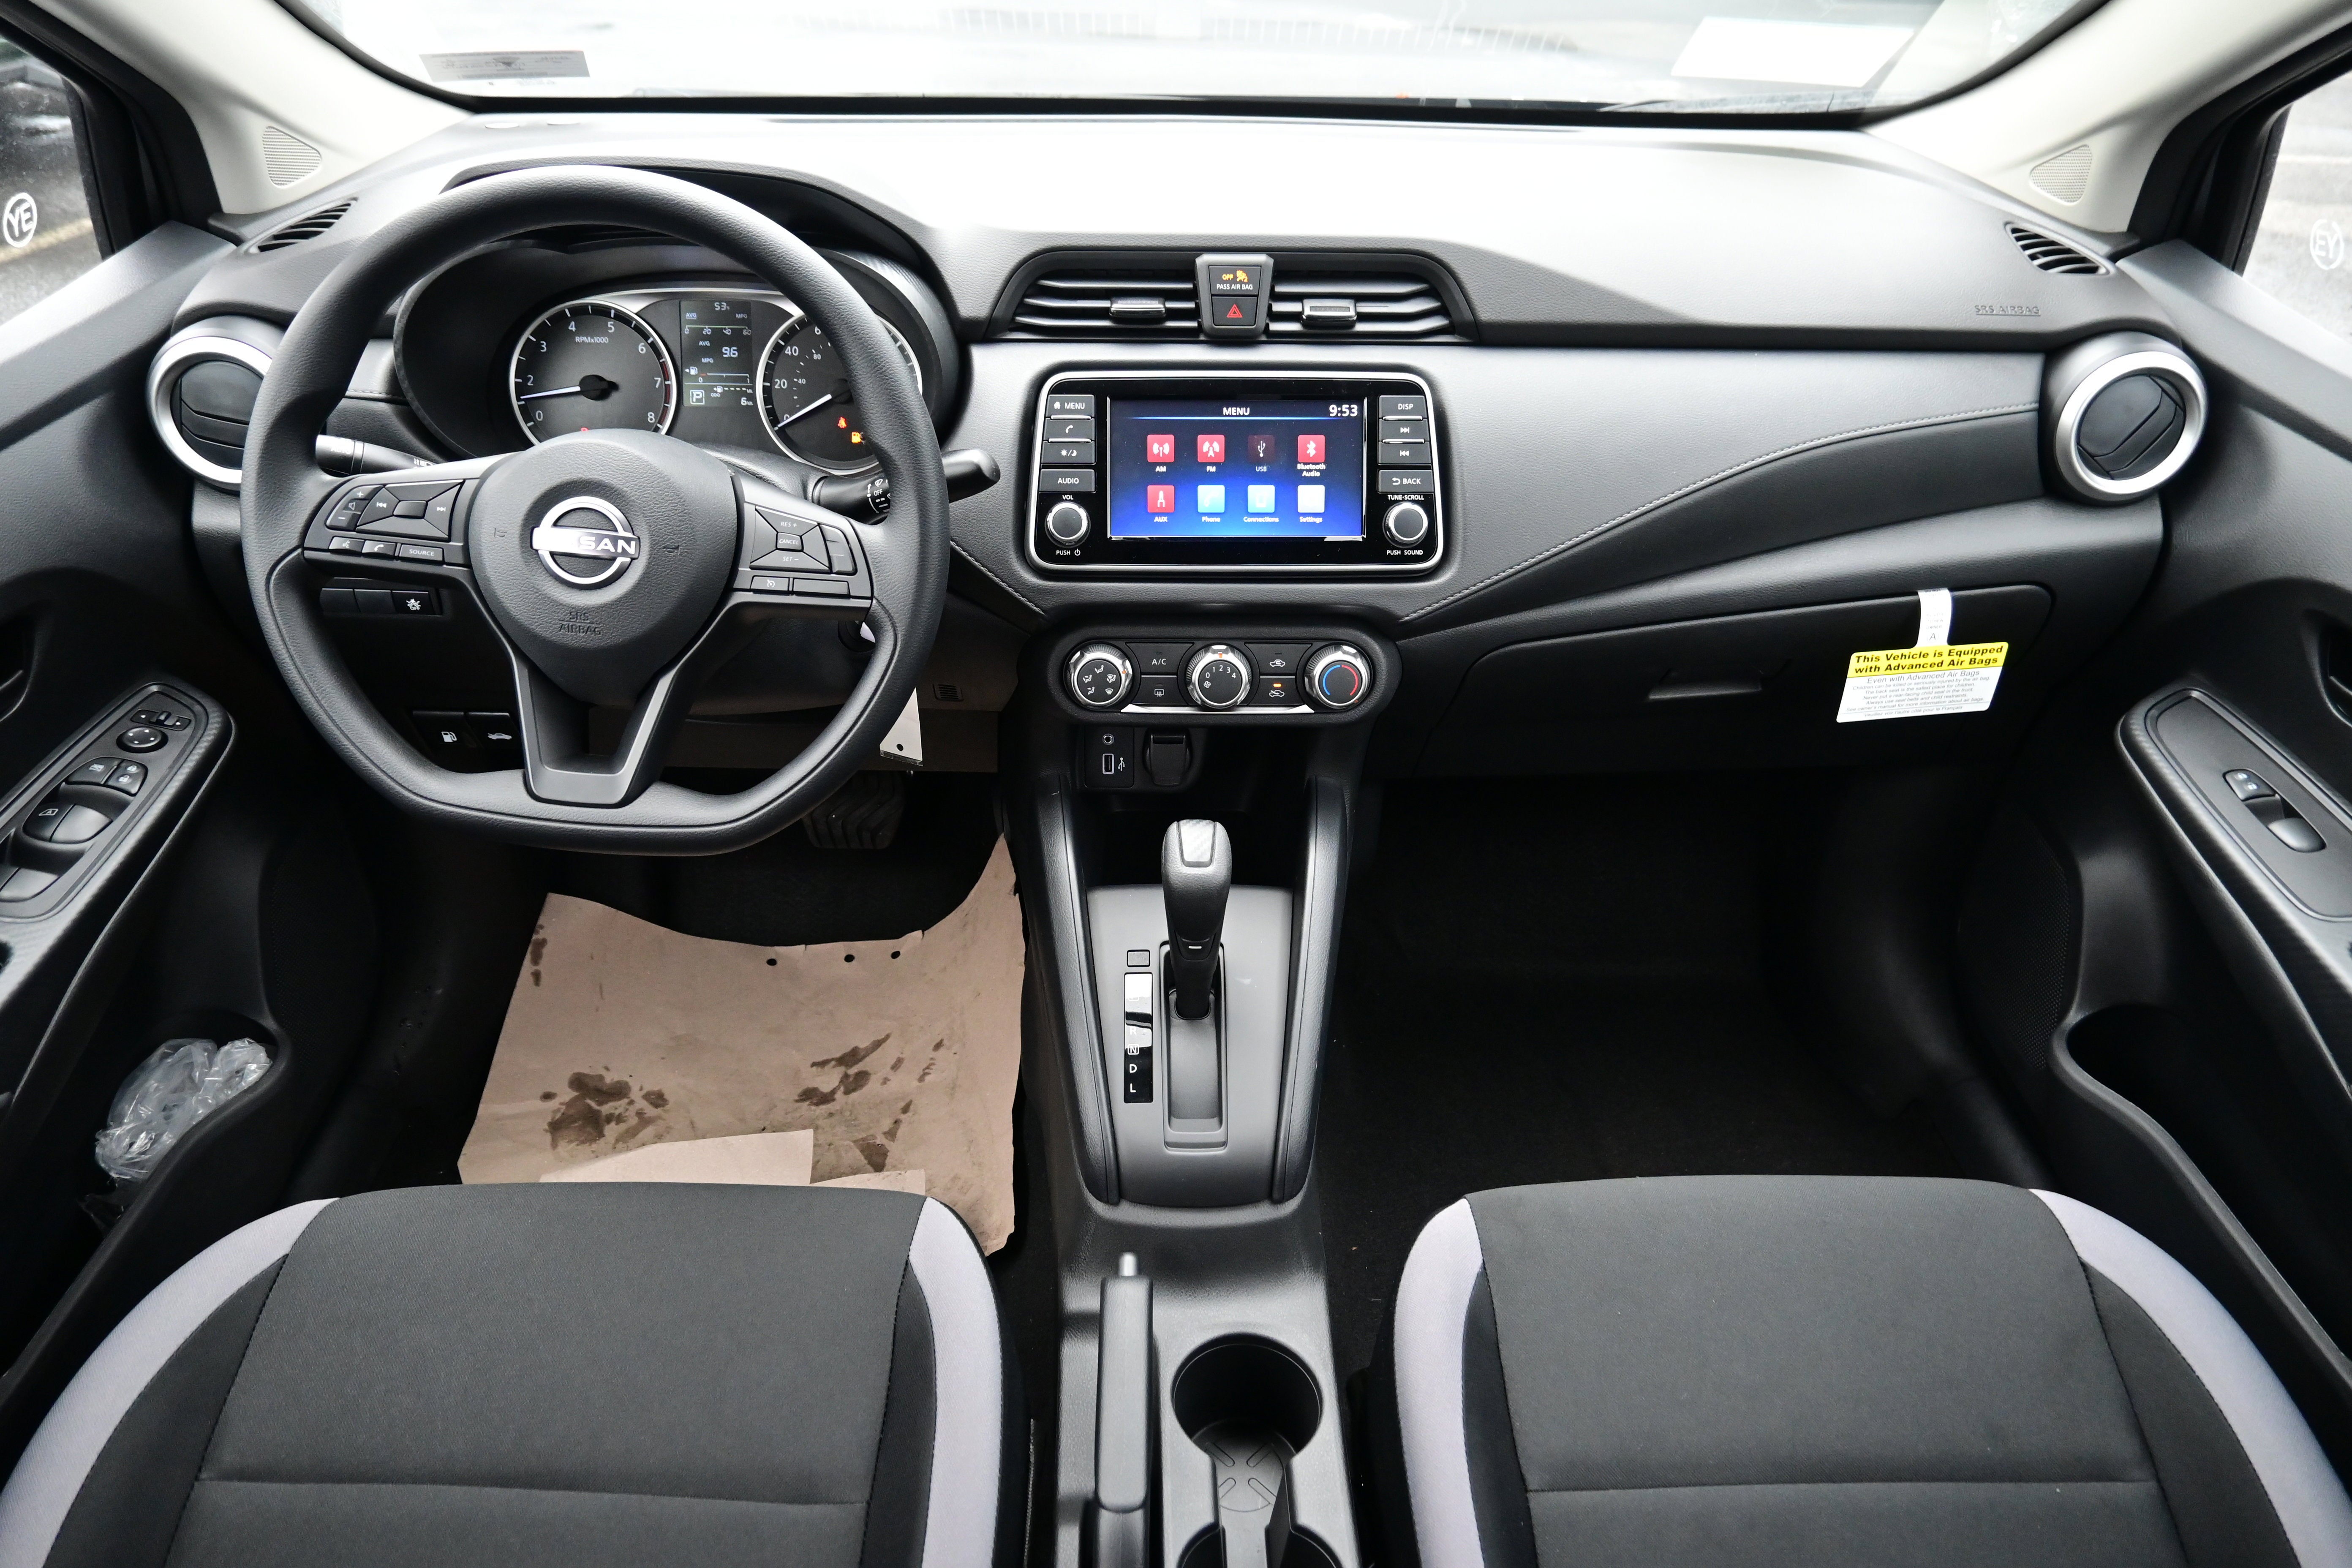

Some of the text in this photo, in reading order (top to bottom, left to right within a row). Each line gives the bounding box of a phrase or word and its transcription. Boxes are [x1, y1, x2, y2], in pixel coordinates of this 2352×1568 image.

[1975, 305, 2039, 314] SRS AIRBAG
[568, 321, 576, 332] 4
[608, 321, 615, 333] 5
[540, 341, 547, 352] 3
[638, 343, 646, 354] 6
[784, 346, 799, 356] 40
[813, 352, 821, 360] 80
[527, 375, 534, 386] 2
[654, 377, 661, 388] 7
[774, 379, 787, 389] 20
[693, 391, 703, 402] P
[740, 397, 747, 406] 6
[536, 410, 543, 421] 0
[1223, 404, 1358, 417] MENU 9:53
[648, 412, 655, 423] 8
[569, 611, 589, 621] SRS
[559, 623, 602, 635] AIRBAG
[1855, 645, 2004, 664] This Vehicle is Equipped
[1855, 657, 1998, 674] with Advanced Air Bags
[1906, 672, 1945, 681] Advanced
[1130, 1027, 1136, 1035] R
[1130, 1045, 1137, 1054] N
[1129, 1064, 1137, 1073] D
[1130, 1083, 1136, 1093] L
